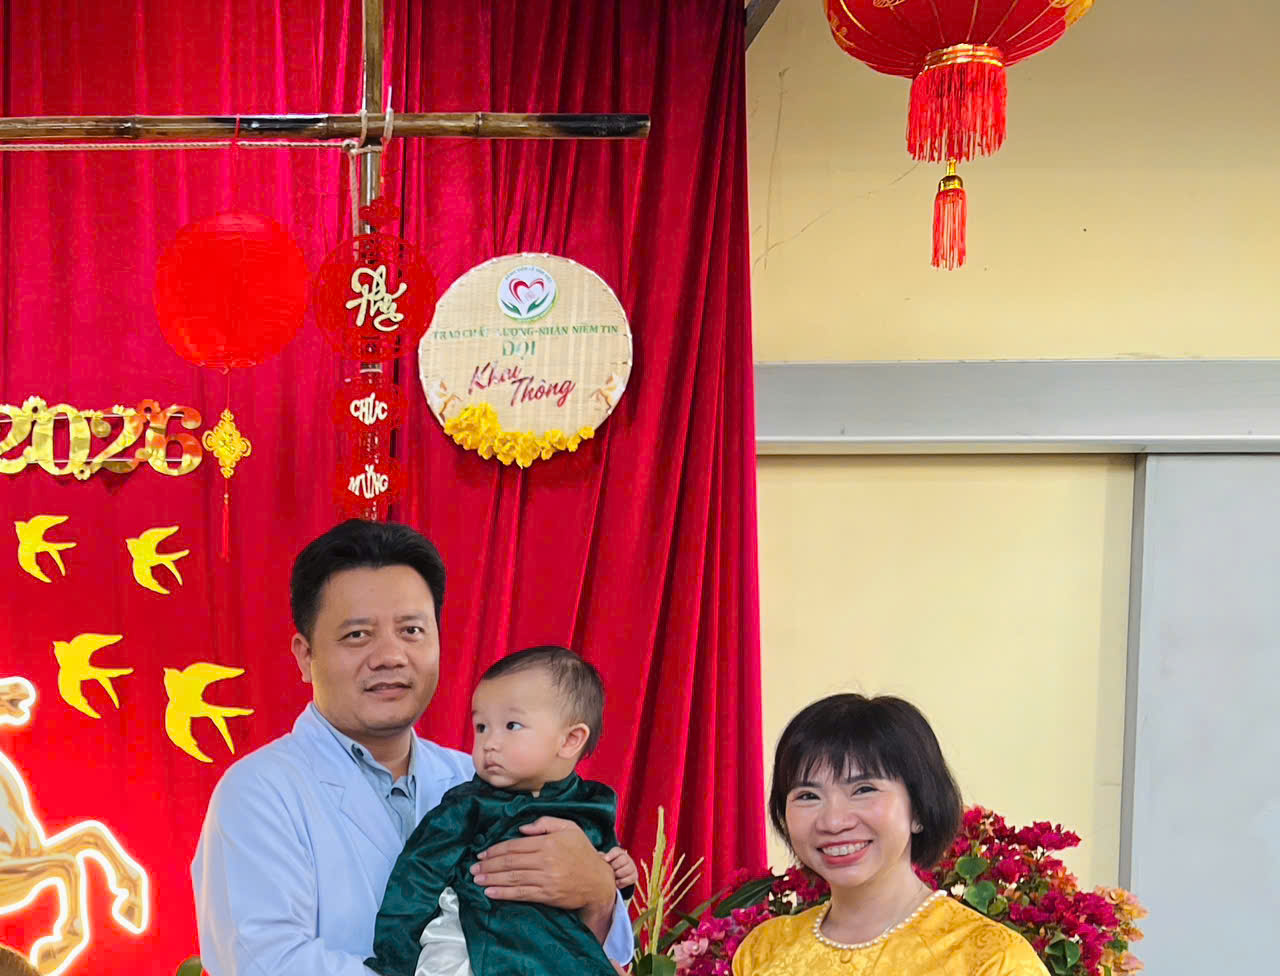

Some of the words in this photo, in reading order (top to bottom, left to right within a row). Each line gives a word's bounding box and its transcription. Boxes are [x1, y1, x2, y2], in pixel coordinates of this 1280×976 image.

[600, 323, 619, 335] TIN
[509, 376, 577, 408] Thông
[350, 392, 388, 426] CHÚC
[348, 463, 389, 499] MỪNG
